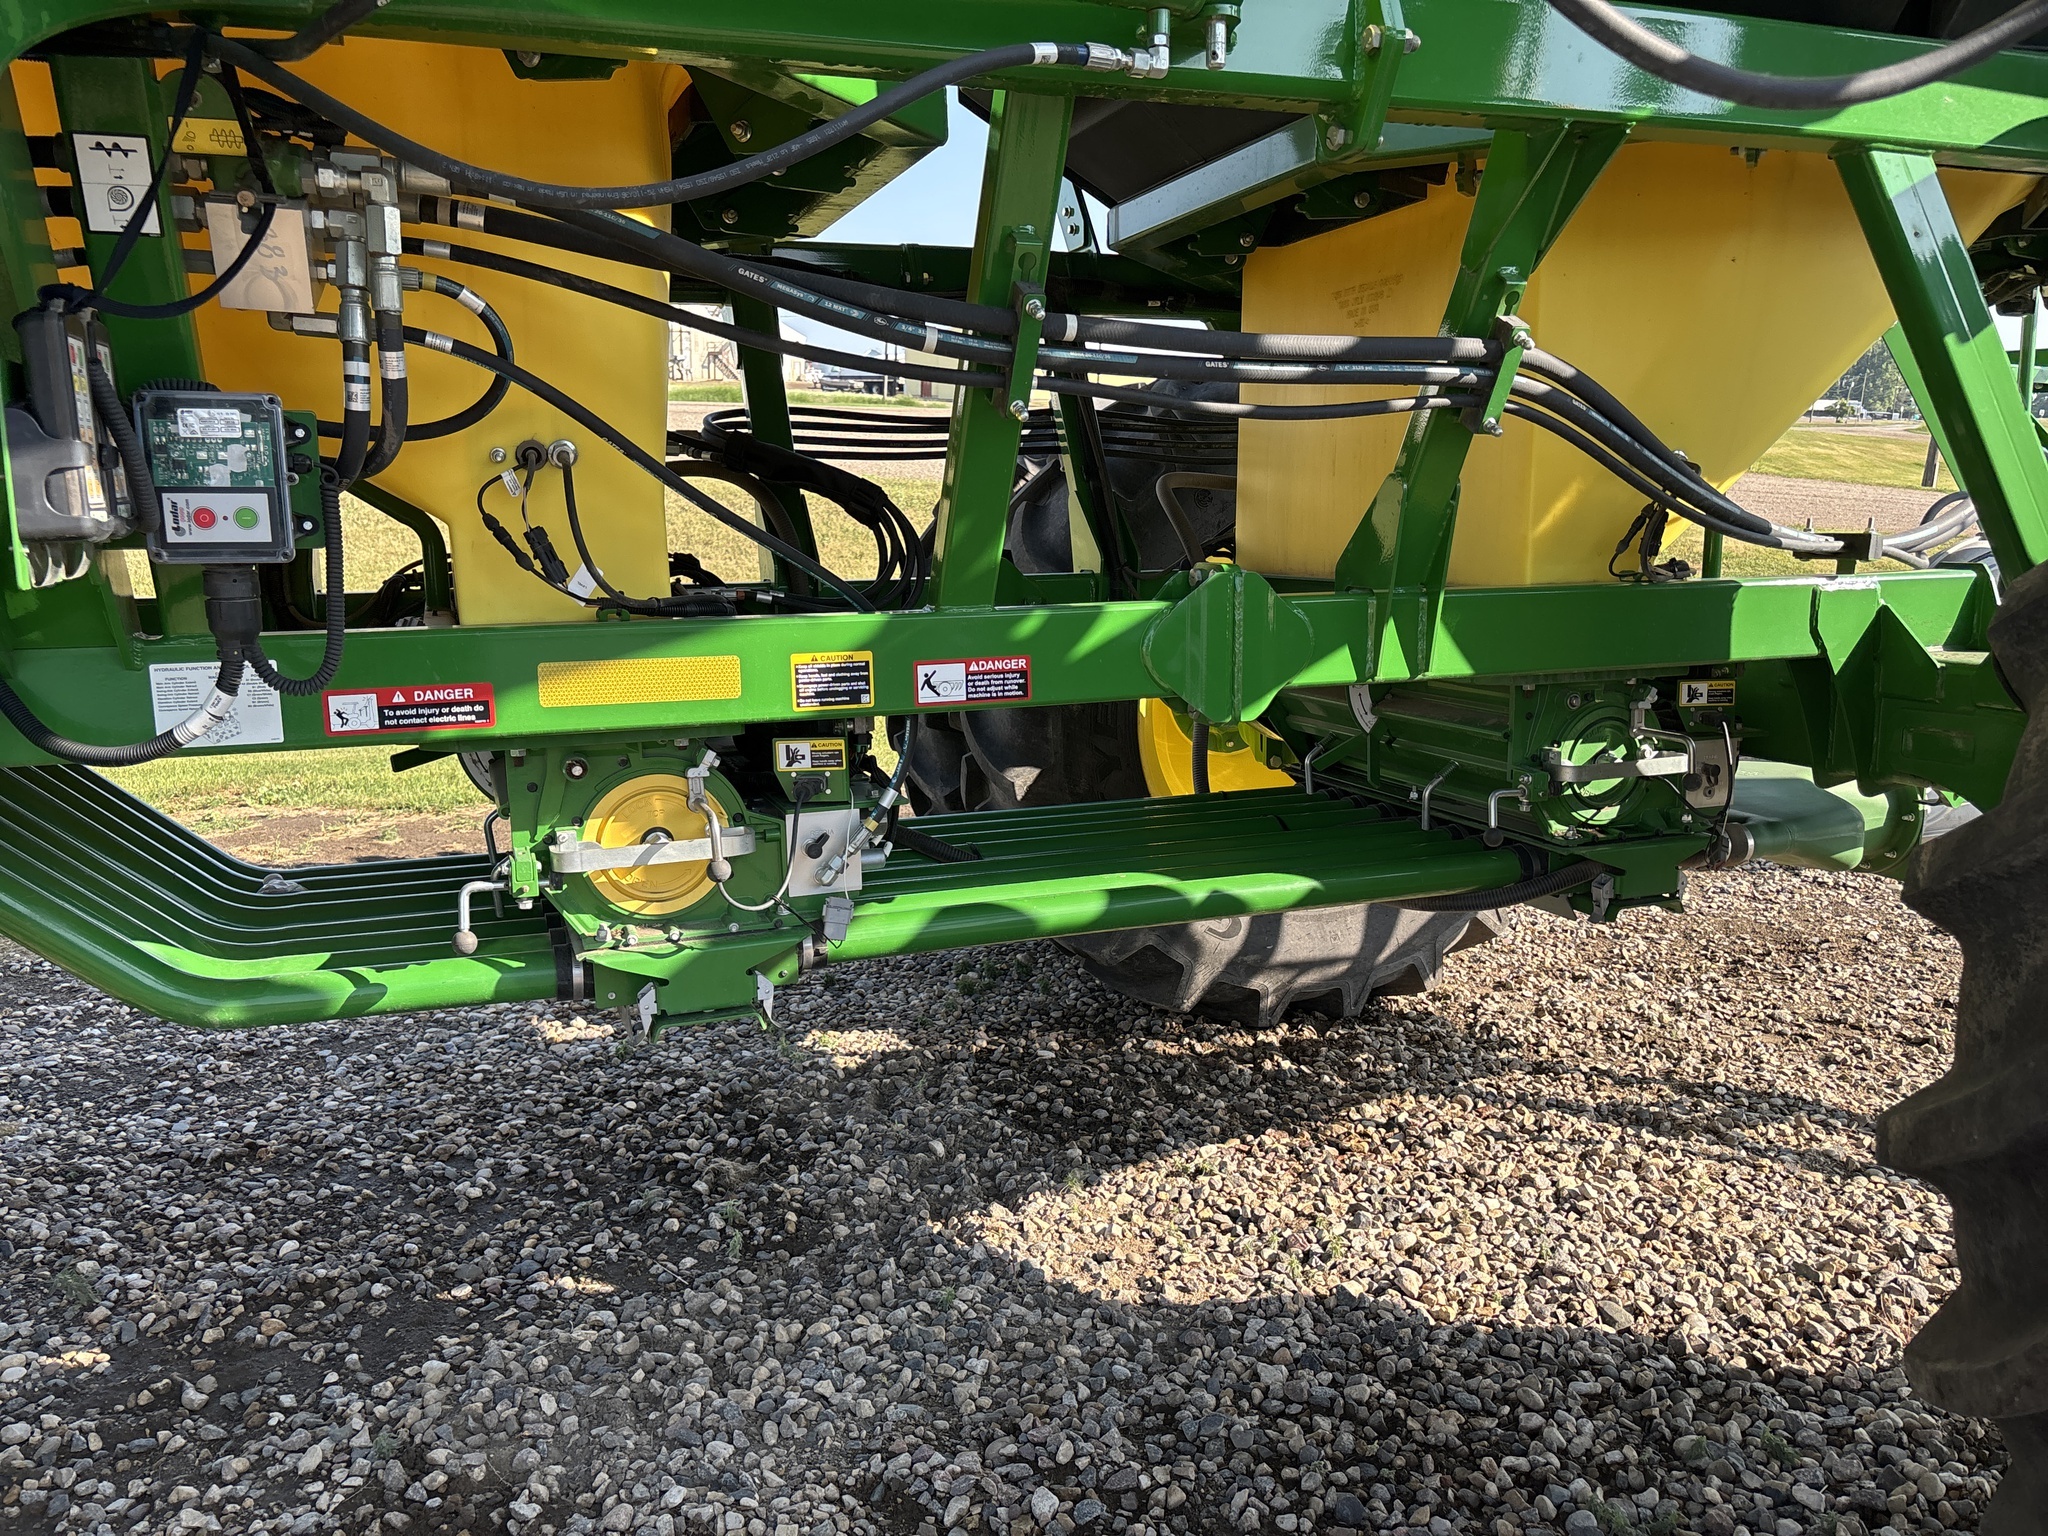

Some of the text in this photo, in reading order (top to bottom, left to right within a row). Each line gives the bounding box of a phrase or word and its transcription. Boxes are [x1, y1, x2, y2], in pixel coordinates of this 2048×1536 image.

[738, 267, 765, 284] GATES
[1205, 361, 1228, 369] GATES
[820, 654, 854, 662] CAUTION
[979, 659, 1027, 671] DANGER
[414, 688, 474, 702] DANGER
[383, 709, 394, 717] To
[396, 708, 417, 716] avoid
[418, 706, 440, 716] injury
[451, 704, 472, 713] death
[473, 704, 485, 712] do
[398, 716, 428, 725] contact
[428, 715, 456, 723] electric
[457, 714, 476, 722] lines
